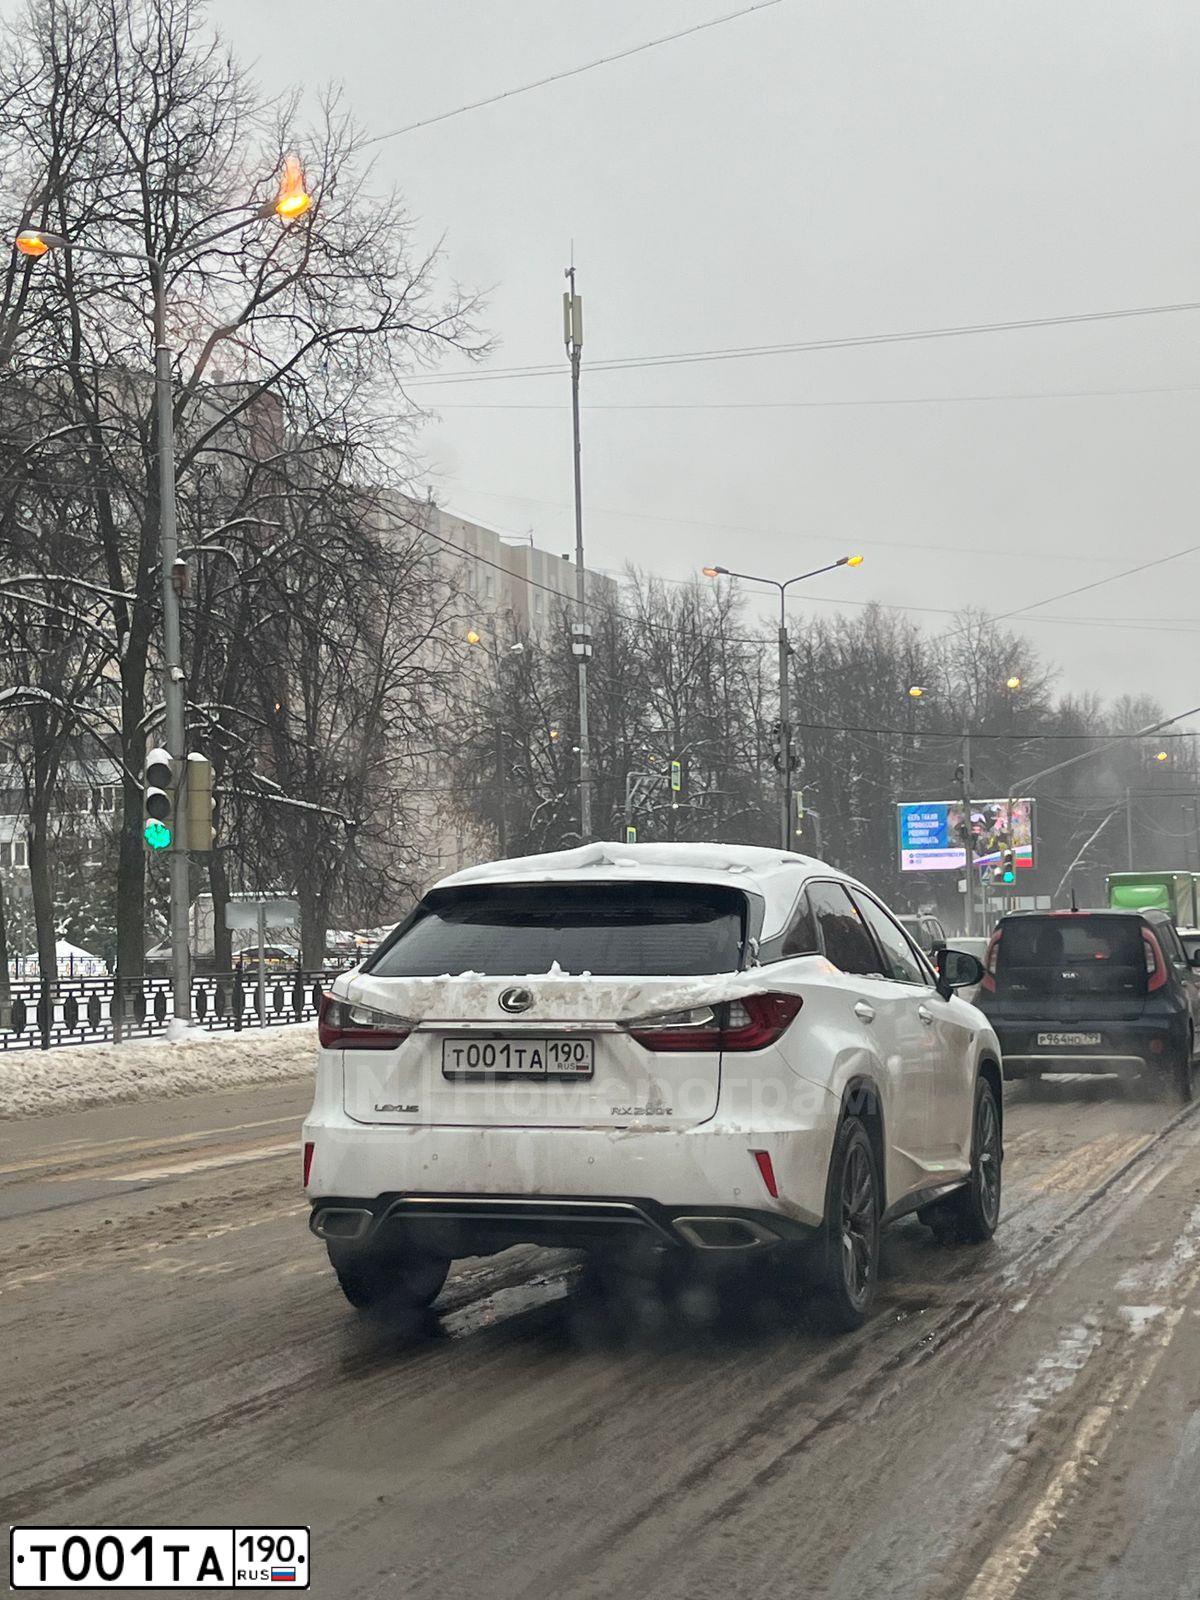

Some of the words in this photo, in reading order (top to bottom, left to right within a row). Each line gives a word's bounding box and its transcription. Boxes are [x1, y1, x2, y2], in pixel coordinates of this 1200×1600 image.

[452, 1043, 543, 1069] Т001ТА
[549, 1043, 585, 1062] 190
[374, 1104, 419, 1112] LEXUS
